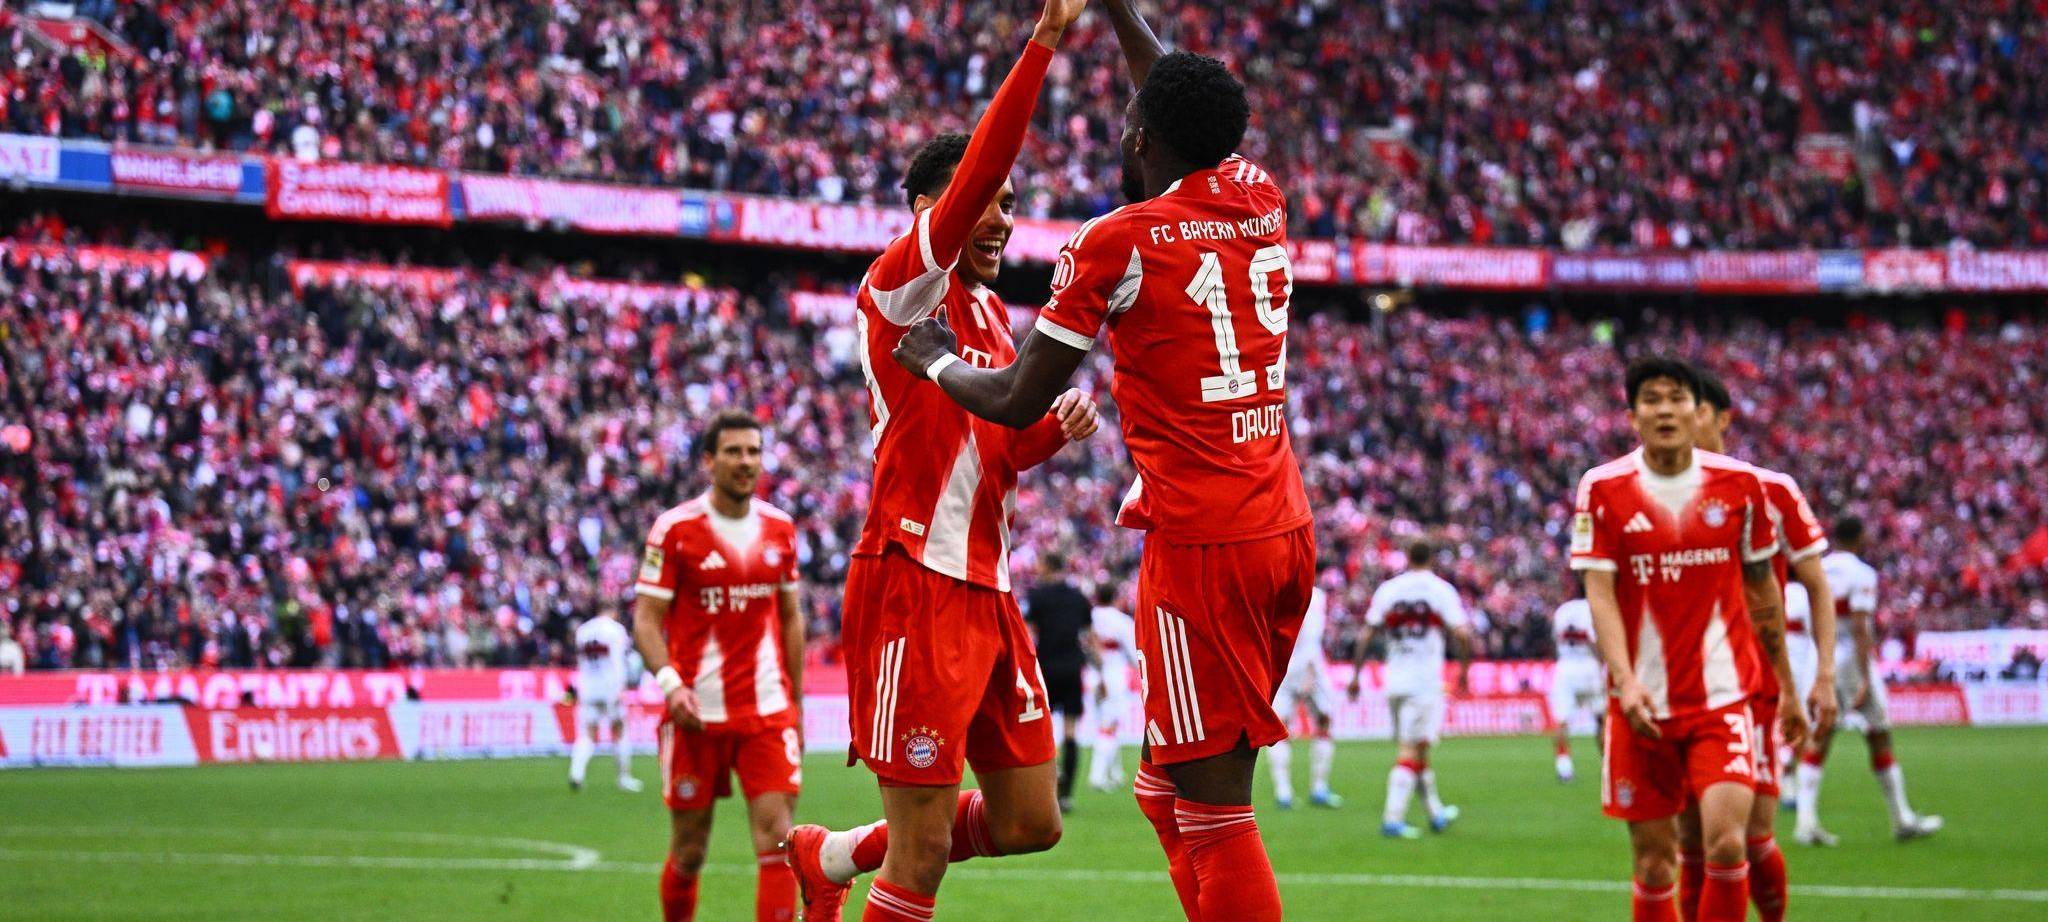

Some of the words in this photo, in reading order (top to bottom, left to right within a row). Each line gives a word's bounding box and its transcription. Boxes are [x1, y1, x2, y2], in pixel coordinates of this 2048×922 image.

[1150, 224, 1175, 245] FC
[1179, 220, 1237, 240] BAYERN
[1237, 206, 1283, 238] MÜNCHE
[1184, 244, 1294, 403] 19
[1660, 565, 1682, 583] TV
[208, 709, 381, 762] Emirates
[781, 726, 800, 766] 8
[1723, 712, 1750, 754] 3
